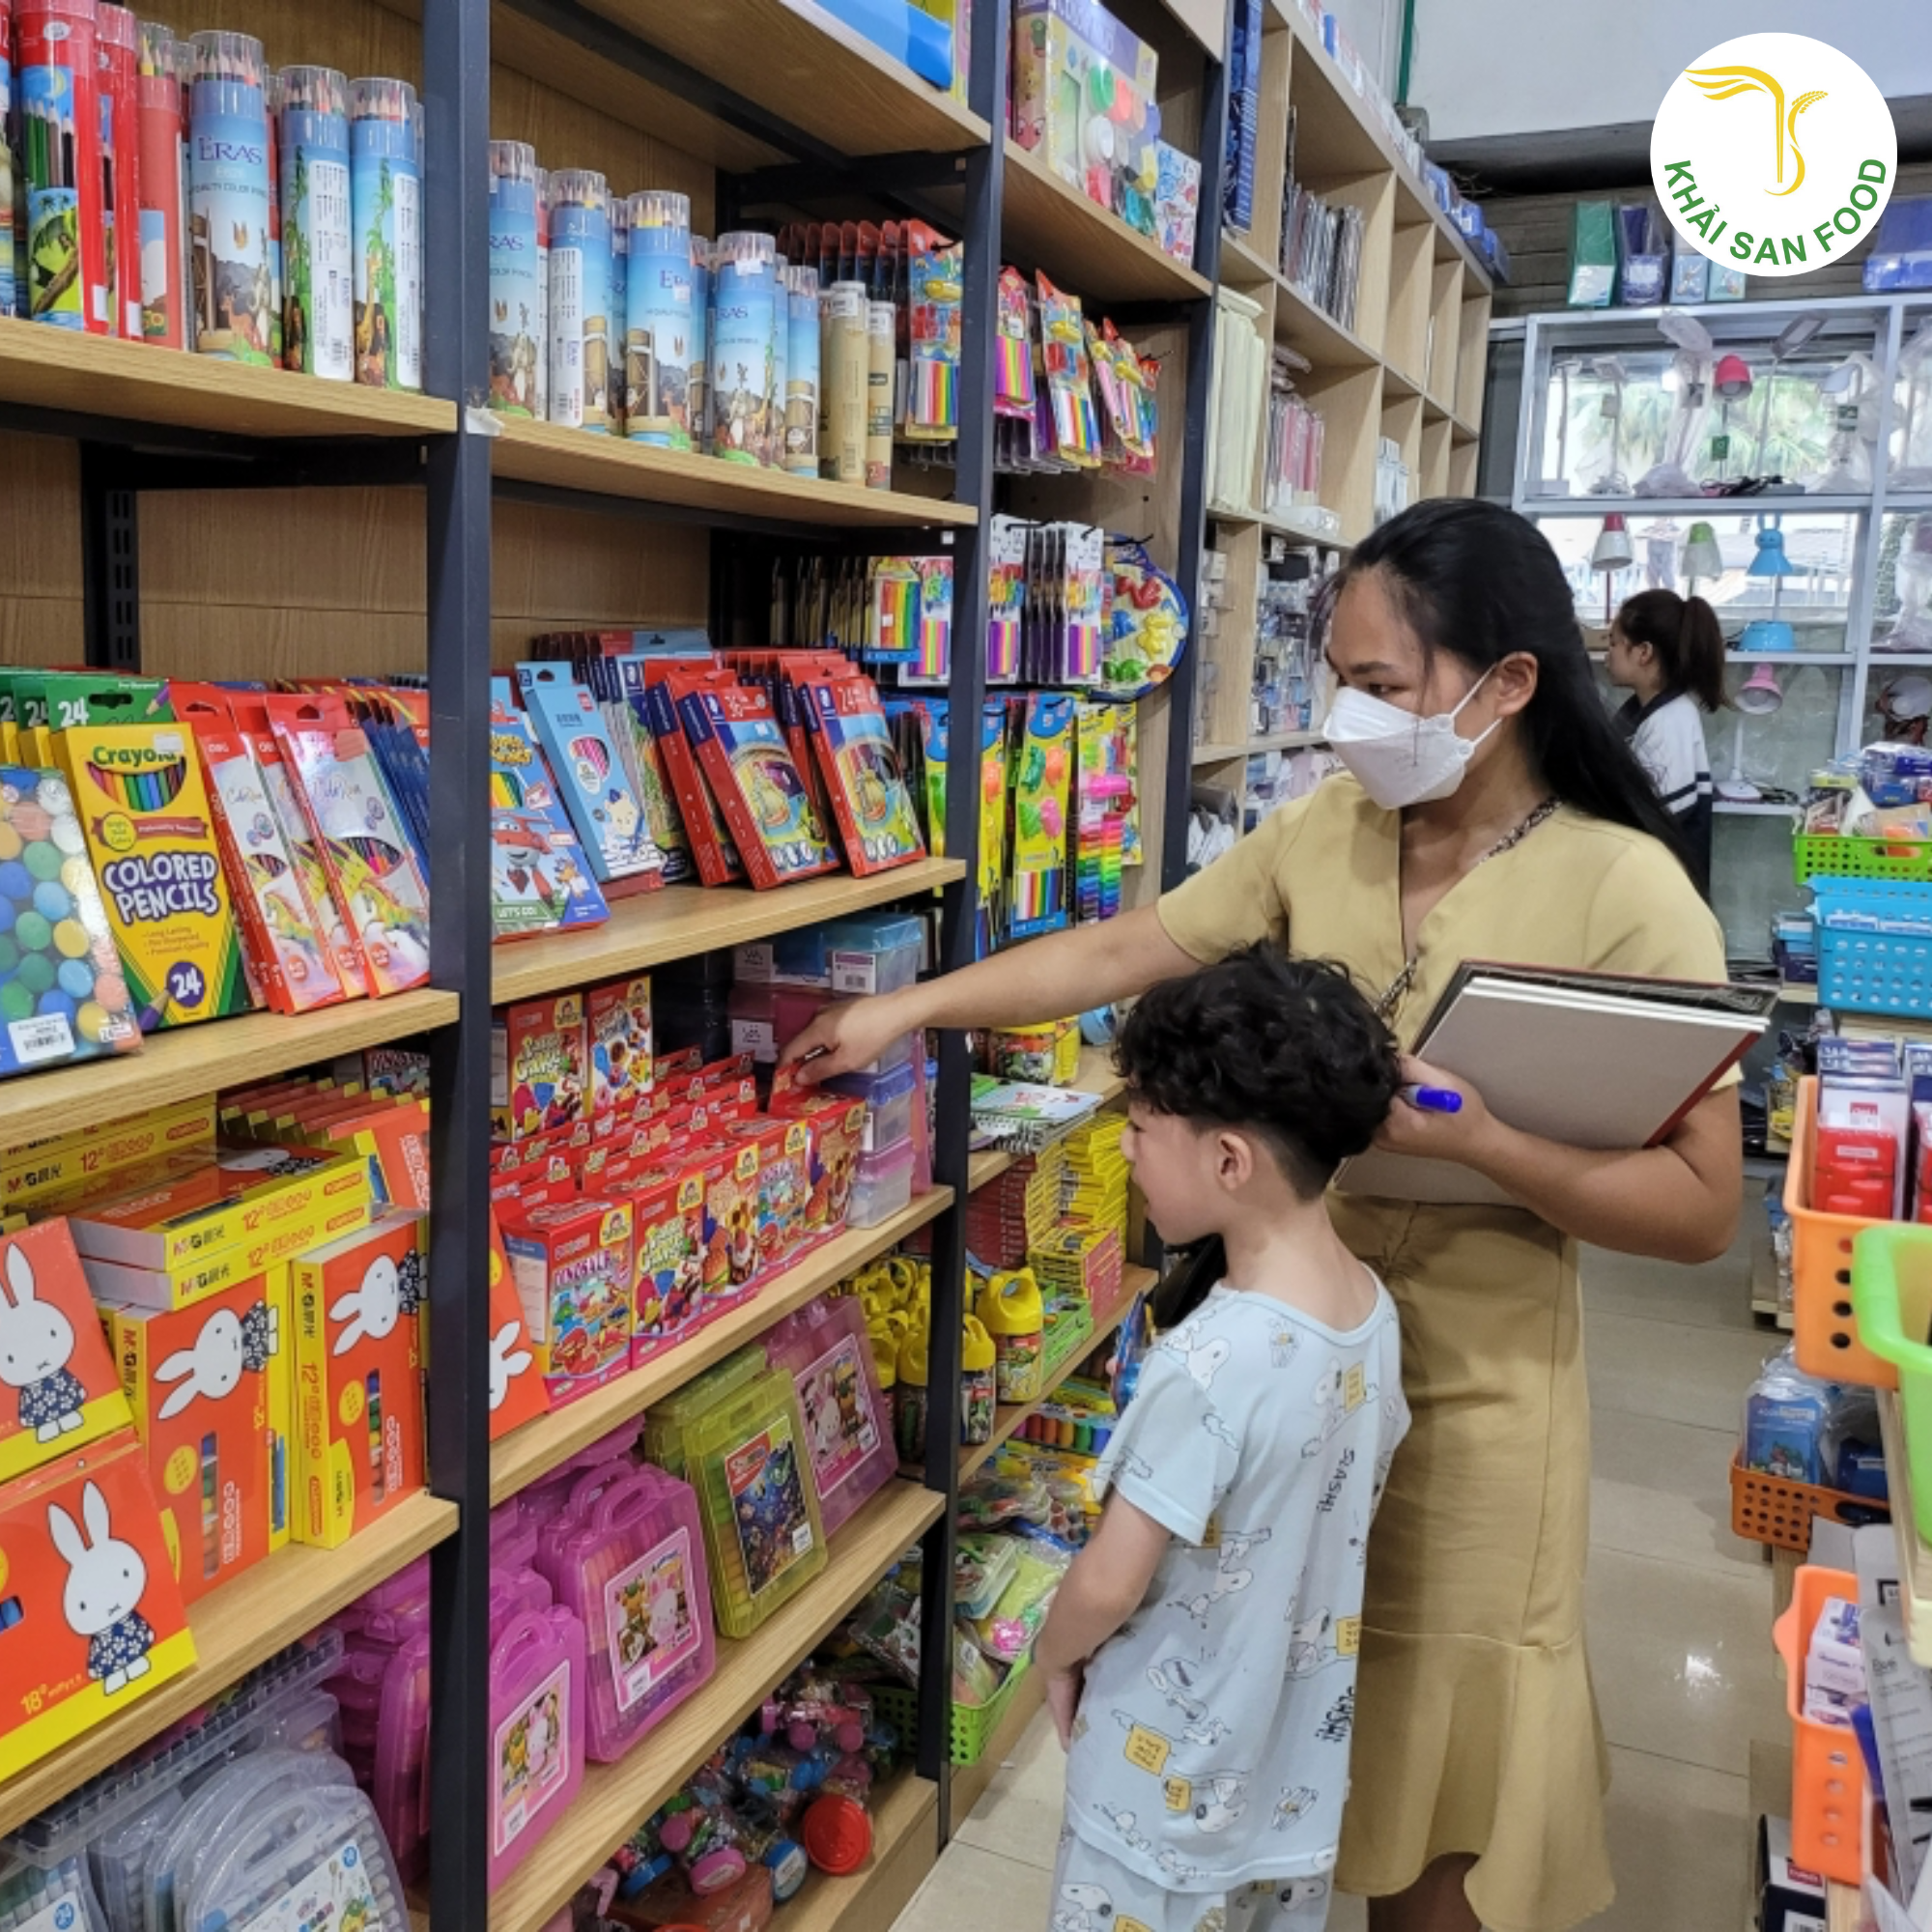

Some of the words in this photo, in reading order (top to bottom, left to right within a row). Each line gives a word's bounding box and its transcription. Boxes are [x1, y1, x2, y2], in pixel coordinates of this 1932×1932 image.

[197, 136, 263, 164] ERAS
[489, 233, 525, 251] RAS
[57, 696, 91, 727] 24
[104, 854, 217, 893] COLORED
[116, 881, 218, 923] PENCILS
[171, 967, 202, 999] 24
